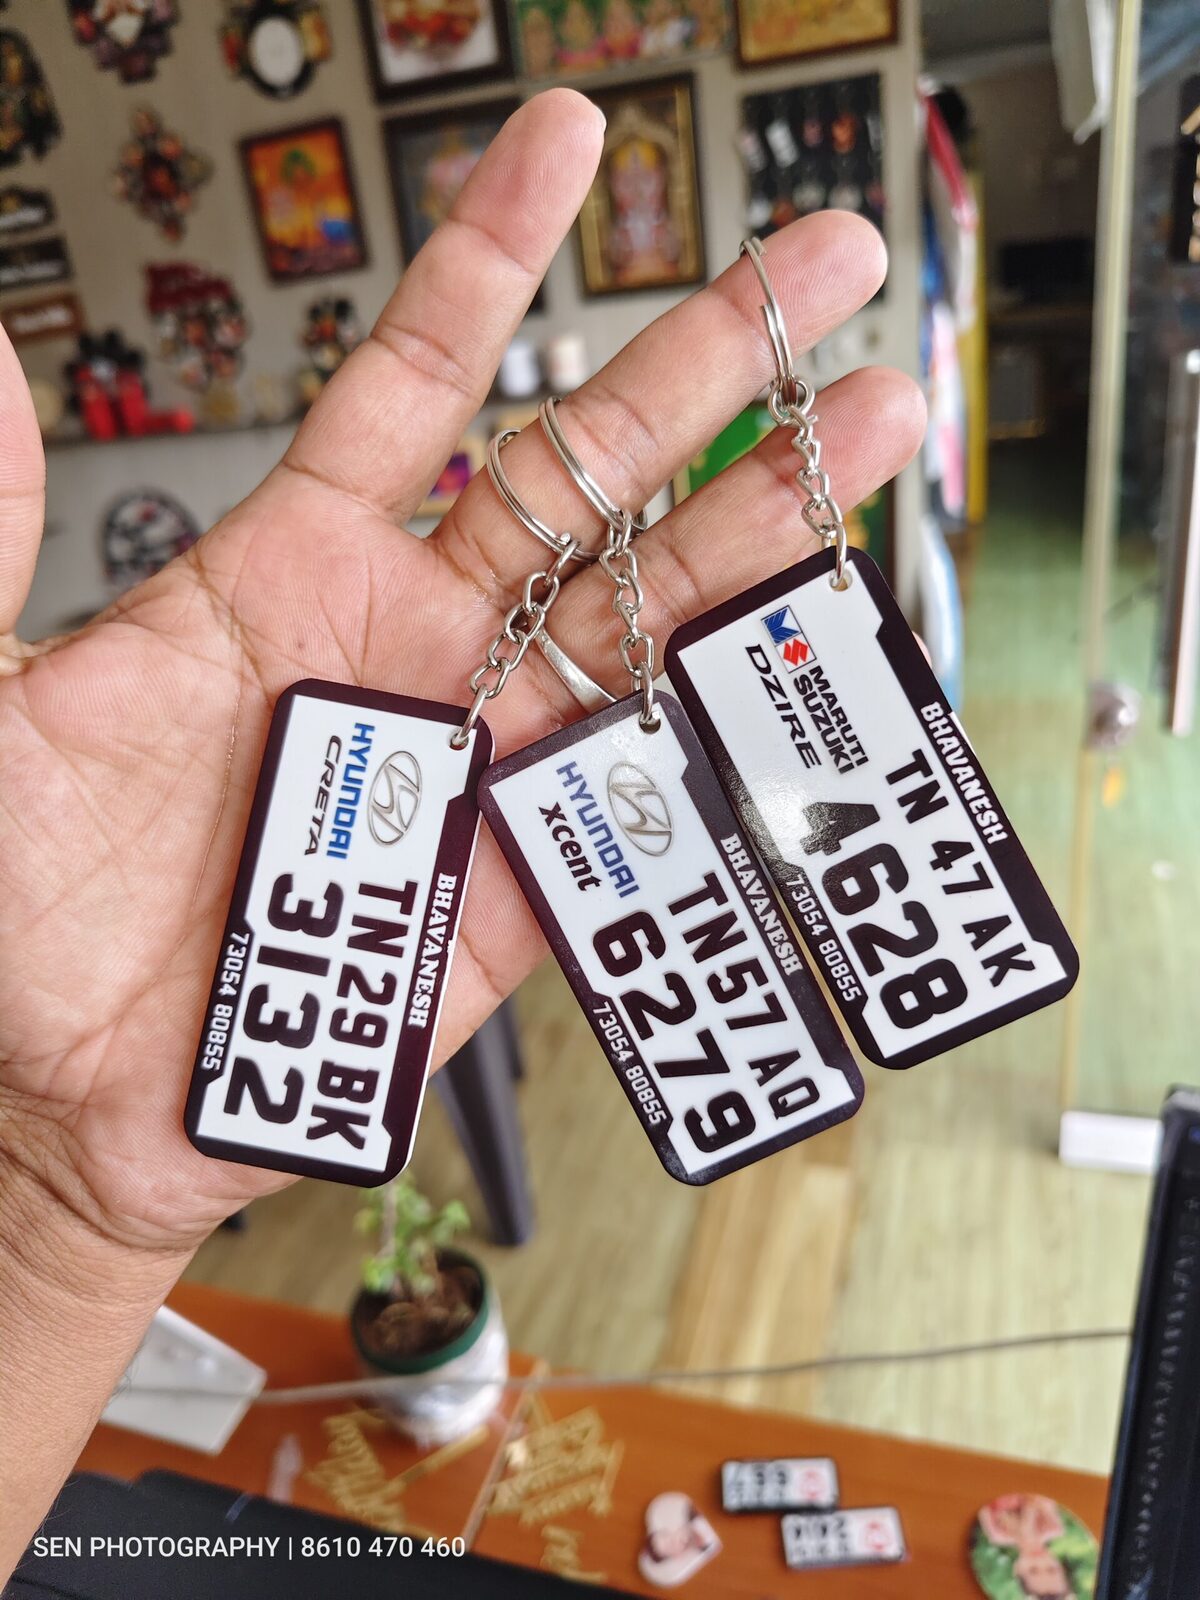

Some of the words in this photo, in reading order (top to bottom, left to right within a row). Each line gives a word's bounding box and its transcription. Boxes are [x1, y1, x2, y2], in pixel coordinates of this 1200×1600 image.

[745, 644, 822, 770] DZIRE
[793, 674, 858, 775] SUZUKI
[810, 666, 870, 768] MARUTI
[304, 736, 341, 856] CRETA
[326, 722, 375, 859] HYUNDAI
[556, 760, 640, 898] HYUNDAI
[920, 701, 1008, 845] BHAVANESH
[538, 802, 602, 892] xcent
[720, 833, 803, 976] BHAVANESH
[885, 748, 949, 825] TN
[929, 840, 993, 897] 47
[962, 914, 1036, 988] AK
[218, 932, 249, 996] 73054
[408, 874, 457, 1028] BHAVANESH
[785, 874, 823, 938] 73054
[819, 938, 862, 1003] 80855
[799, 801, 969, 1030] 4628
[201, 1002, 233, 1071] 80855
[223, 873, 345, 1126] 3132
[592, 908, 757, 1154] 6279
[592, 1001, 634, 1062] 73054
[625, 1064, 667, 1125] 80855
[306, 1060, 380, 1152] BK
[748, 1049, 820, 1121] AQ
